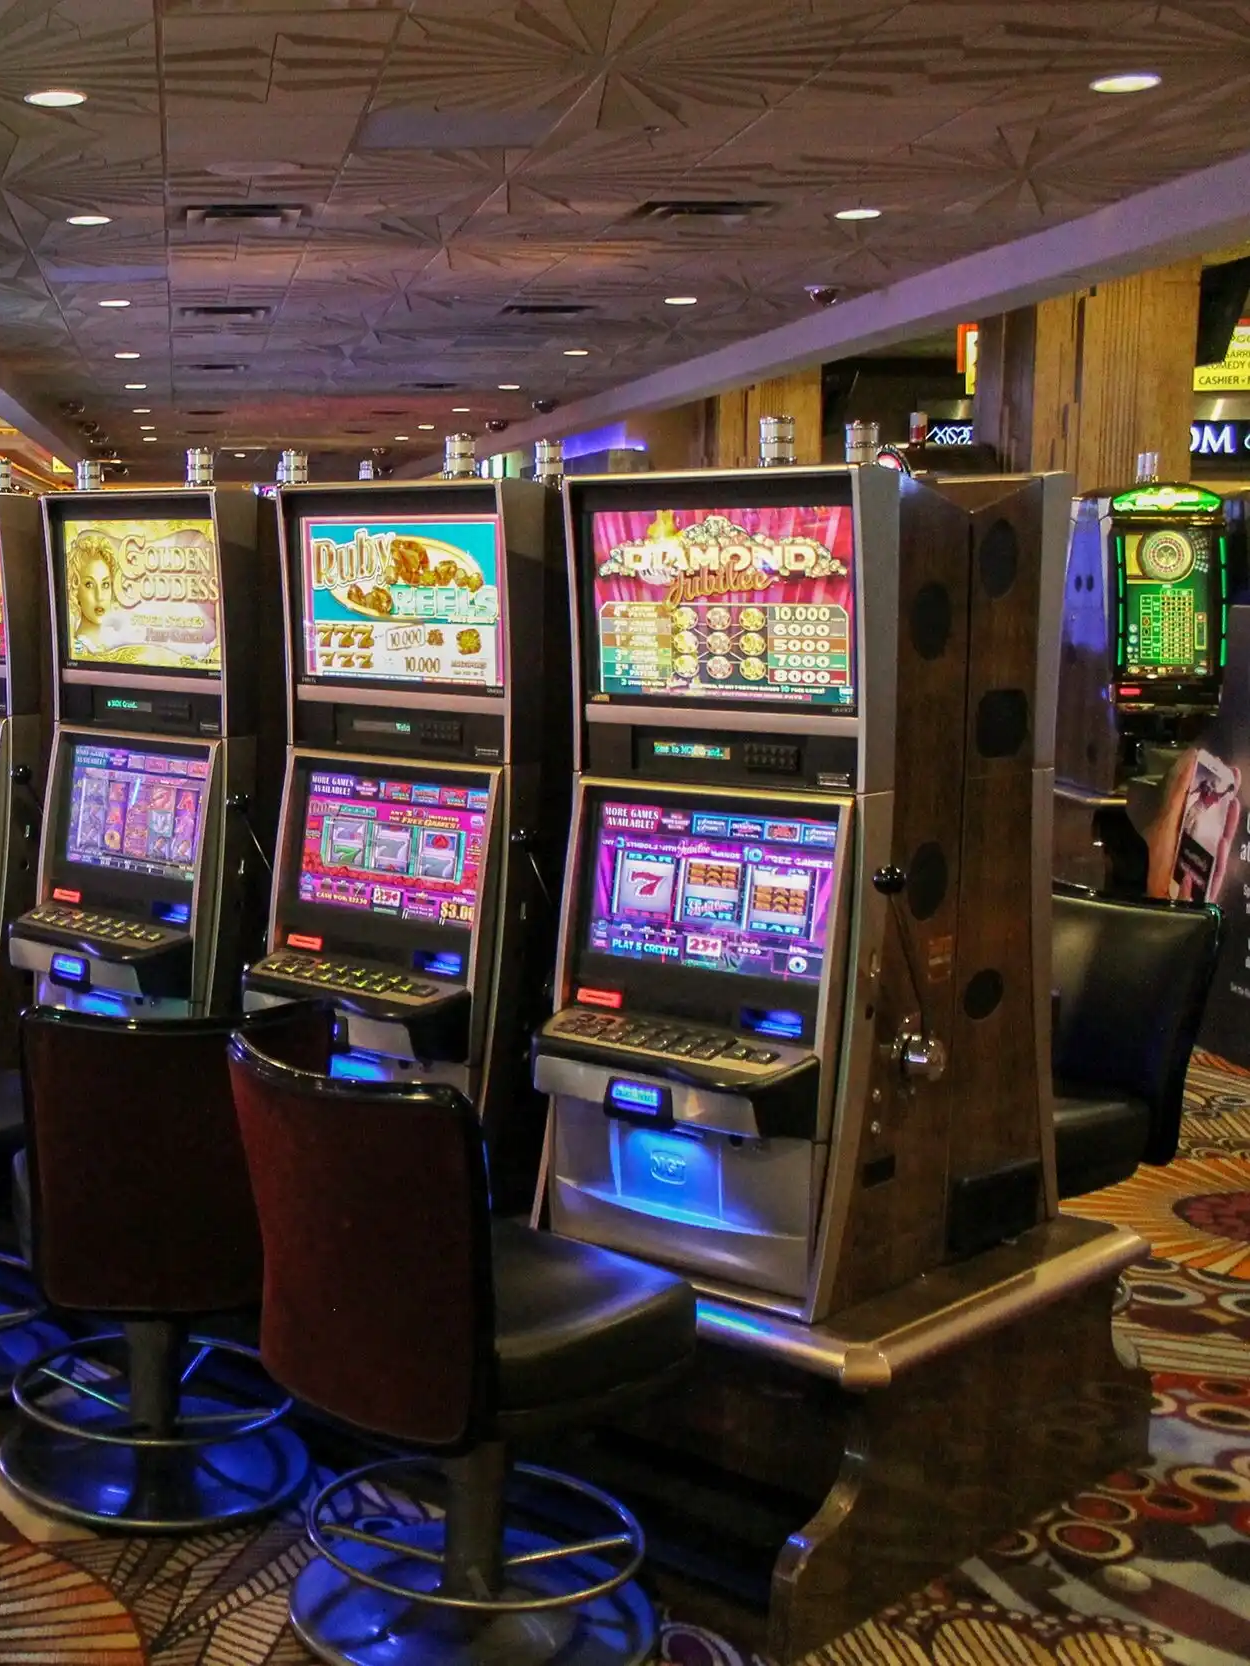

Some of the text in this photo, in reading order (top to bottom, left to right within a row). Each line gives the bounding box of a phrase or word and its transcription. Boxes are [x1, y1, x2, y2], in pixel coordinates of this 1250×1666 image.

[1199, 376, 1239, 385] CASHIER
[118, 534, 211, 580] GOLDEN
[313, 529, 396, 588] Ruby
[624, 544, 819, 572] DIAMOND
[114, 572, 219, 608] GODDESS
[664, 561, 776, 609] Jubilee
[390, 585, 498, 617] REELS
[774, 607, 830, 621] 10,000
[773, 623, 830, 636] 6000
[773, 639, 830, 652] 5000
[773, 655, 830, 667] 7000
[773, 670, 830, 683] 8000
[312, 775, 354, 787] MORE GAMES
[313, 785, 351, 796] AVAILABLE!
[605, 806, 659, 820] MORE GAMES
[401, 816, 423, 825] FREE
[607, 817, 655, 830] AVAILABLE!
[743, 845, 763, 862] 10
[612, 938, 634, 950] PLAY
[643, 942, 680, 957] CREDITS
